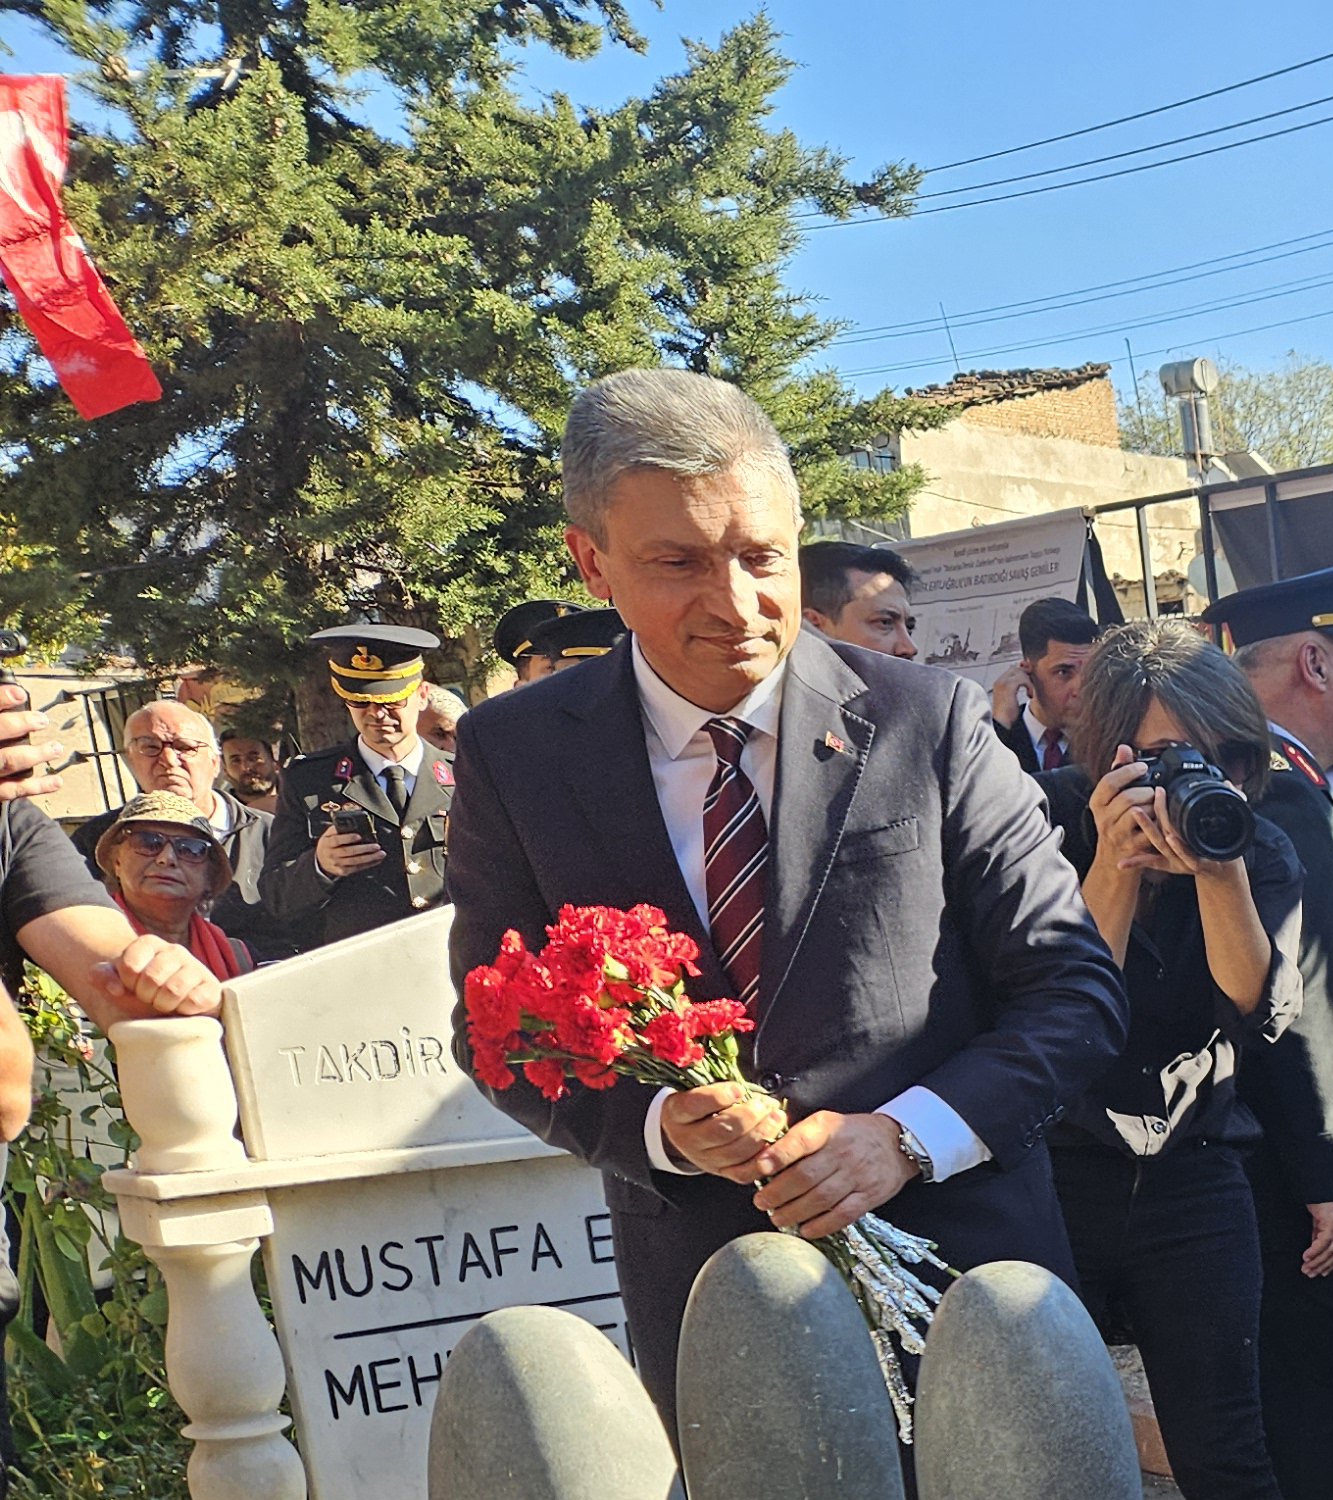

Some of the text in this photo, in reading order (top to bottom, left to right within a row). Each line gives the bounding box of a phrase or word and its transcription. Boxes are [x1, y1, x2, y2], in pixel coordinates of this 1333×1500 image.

[277, 1025, 448, 1088] TAKDİR
[291, 1222, 563, 1304] MUSTAFA
[324, 1350, 452, 1420] MEH
